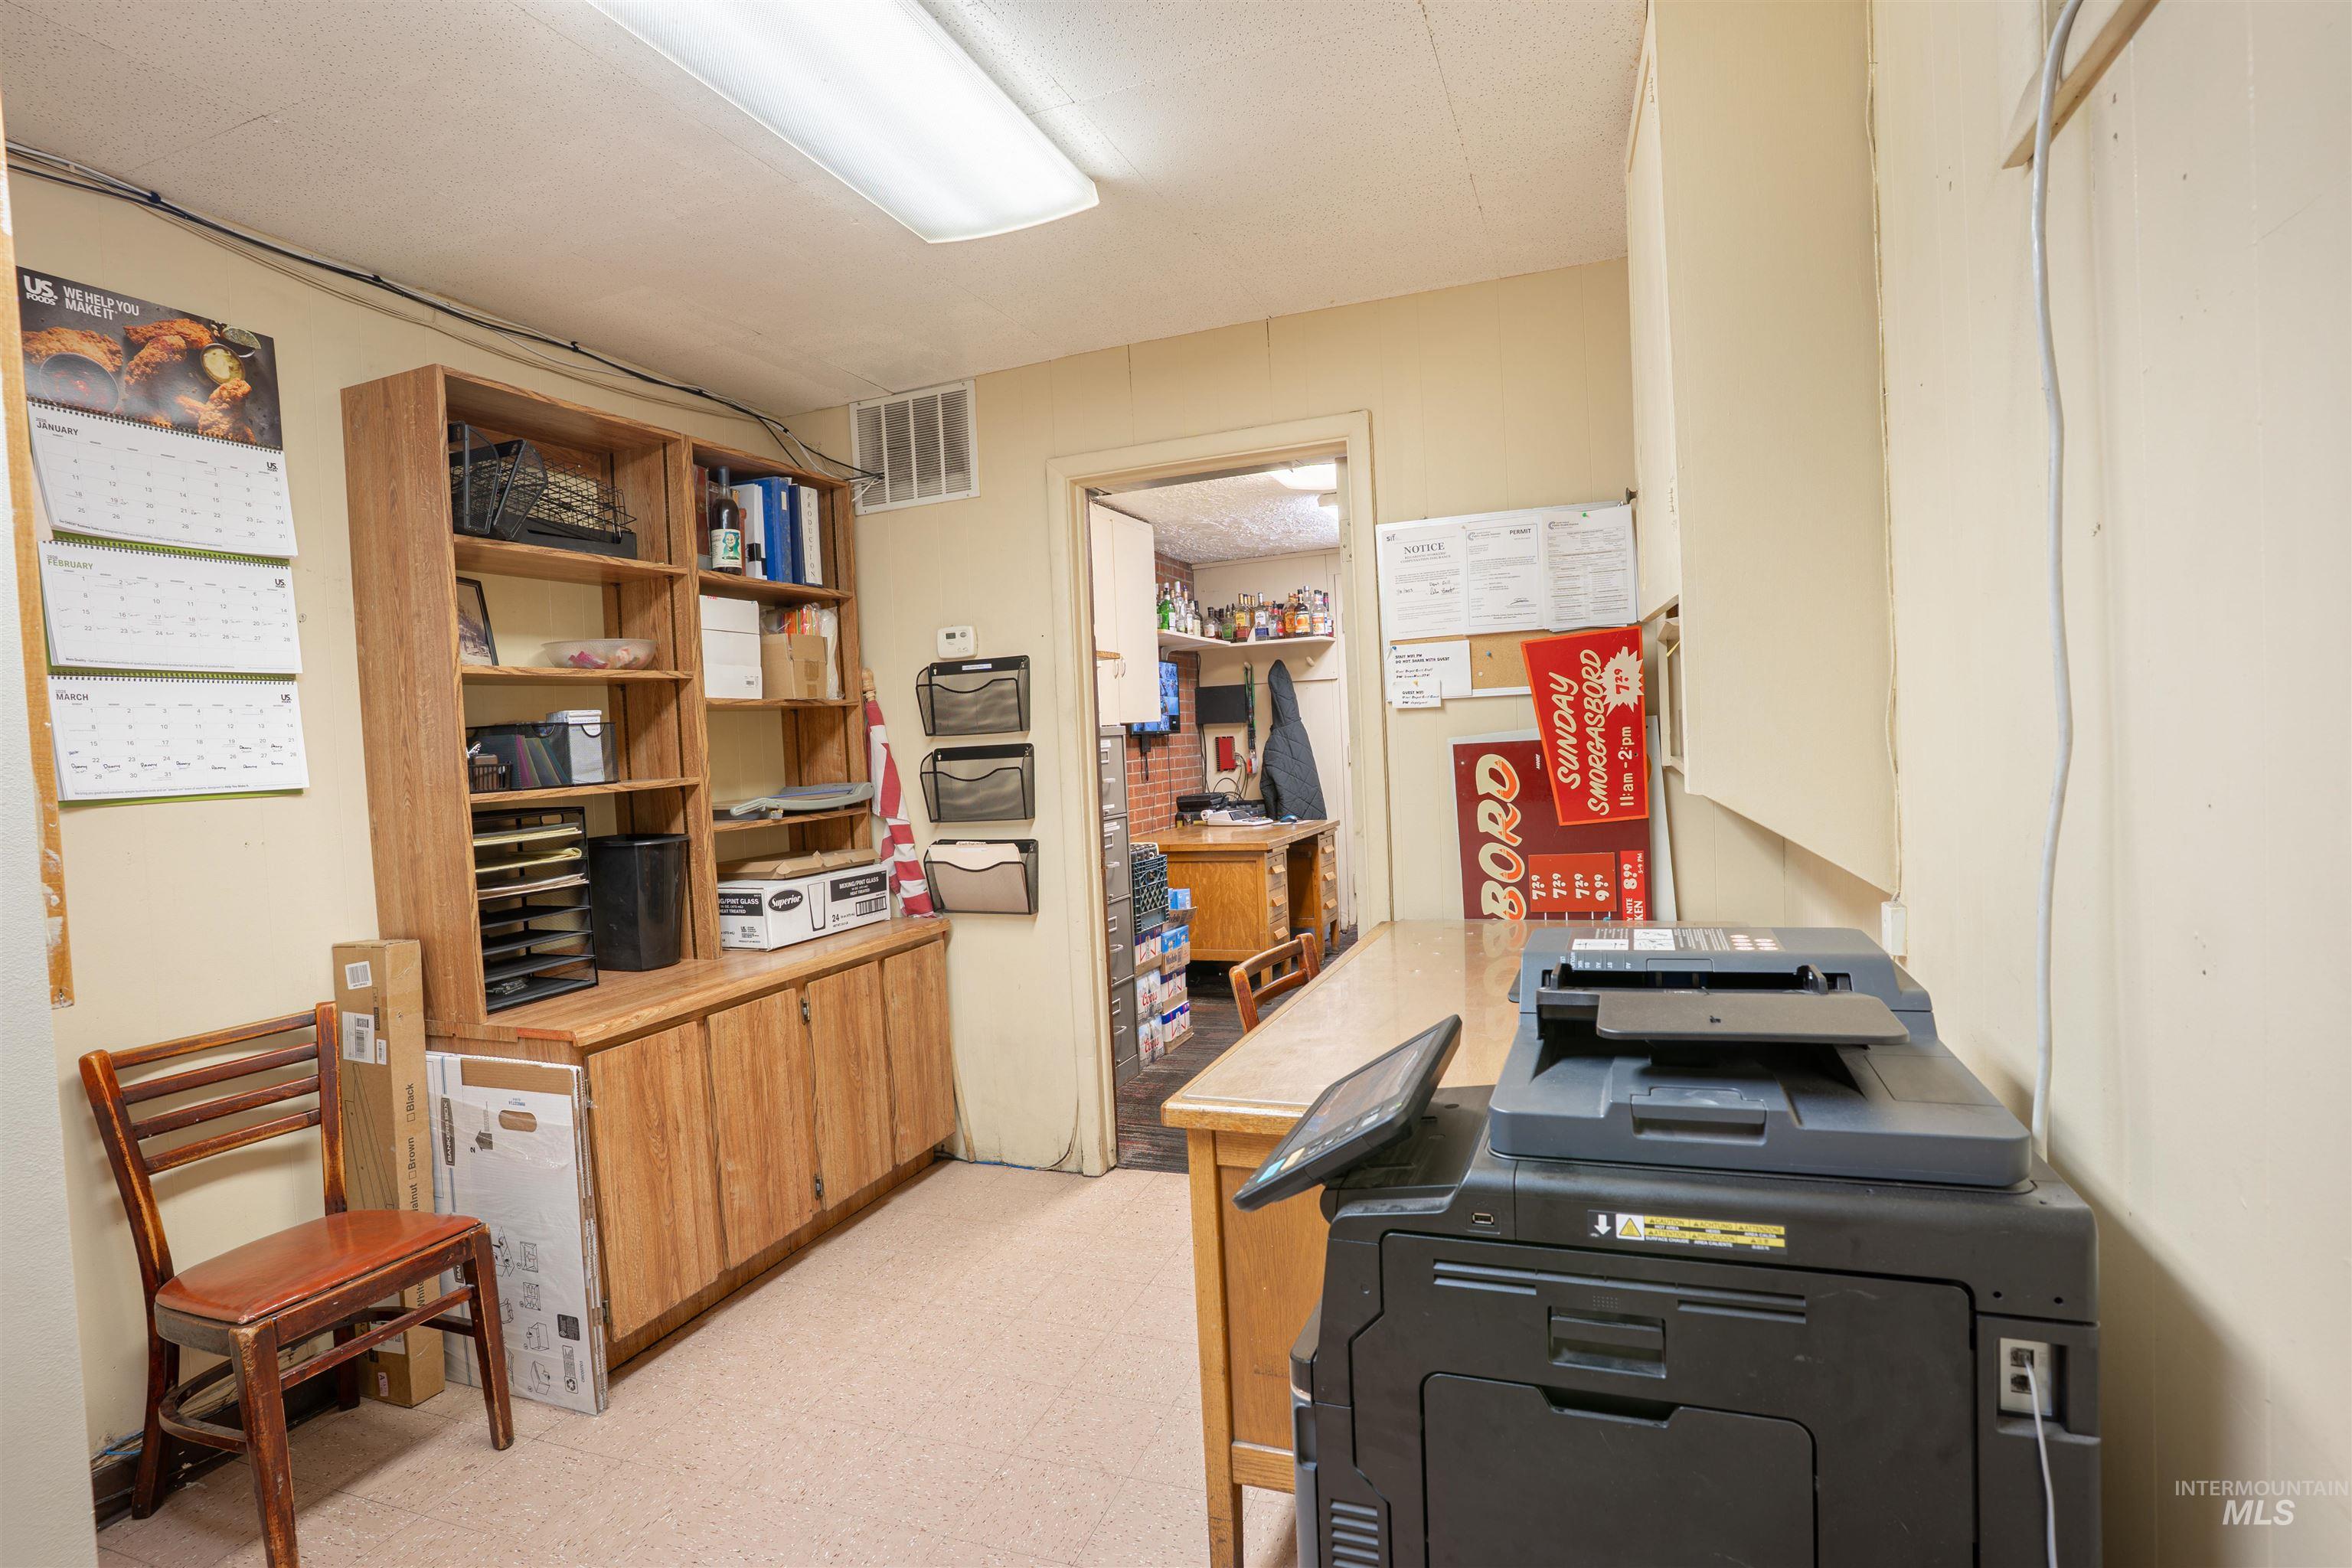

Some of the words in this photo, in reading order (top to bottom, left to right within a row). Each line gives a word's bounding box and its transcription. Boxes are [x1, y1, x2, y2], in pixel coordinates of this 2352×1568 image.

[26, 292, 56, 305] FOODS
[63, 286, 83, 301] WE
[85, 292, 114, 309] HELP
[116, 300, 139, 316] YOU
[65, 299, 101, 317] MAKE
[37, 422, 79, 436] JANUARY
[1404, 542, 1445, 554] NOTICE
[47, 559, 93, 570] FEBRUARY
[1547, 671, 1580, 790] SUNDAY
[1579, 648, 1610, 815] SMORGASBORD
[1638, 853, 1643, 861] PM
[839, 879, 865, 889] MIXING/PINT
[831, 914, 839, 923] 24
[1142, 991, 1158, 1006] Coors
[406, 1083, 414, 1112] Black
[408, 1137, 416, 1170] Brown
